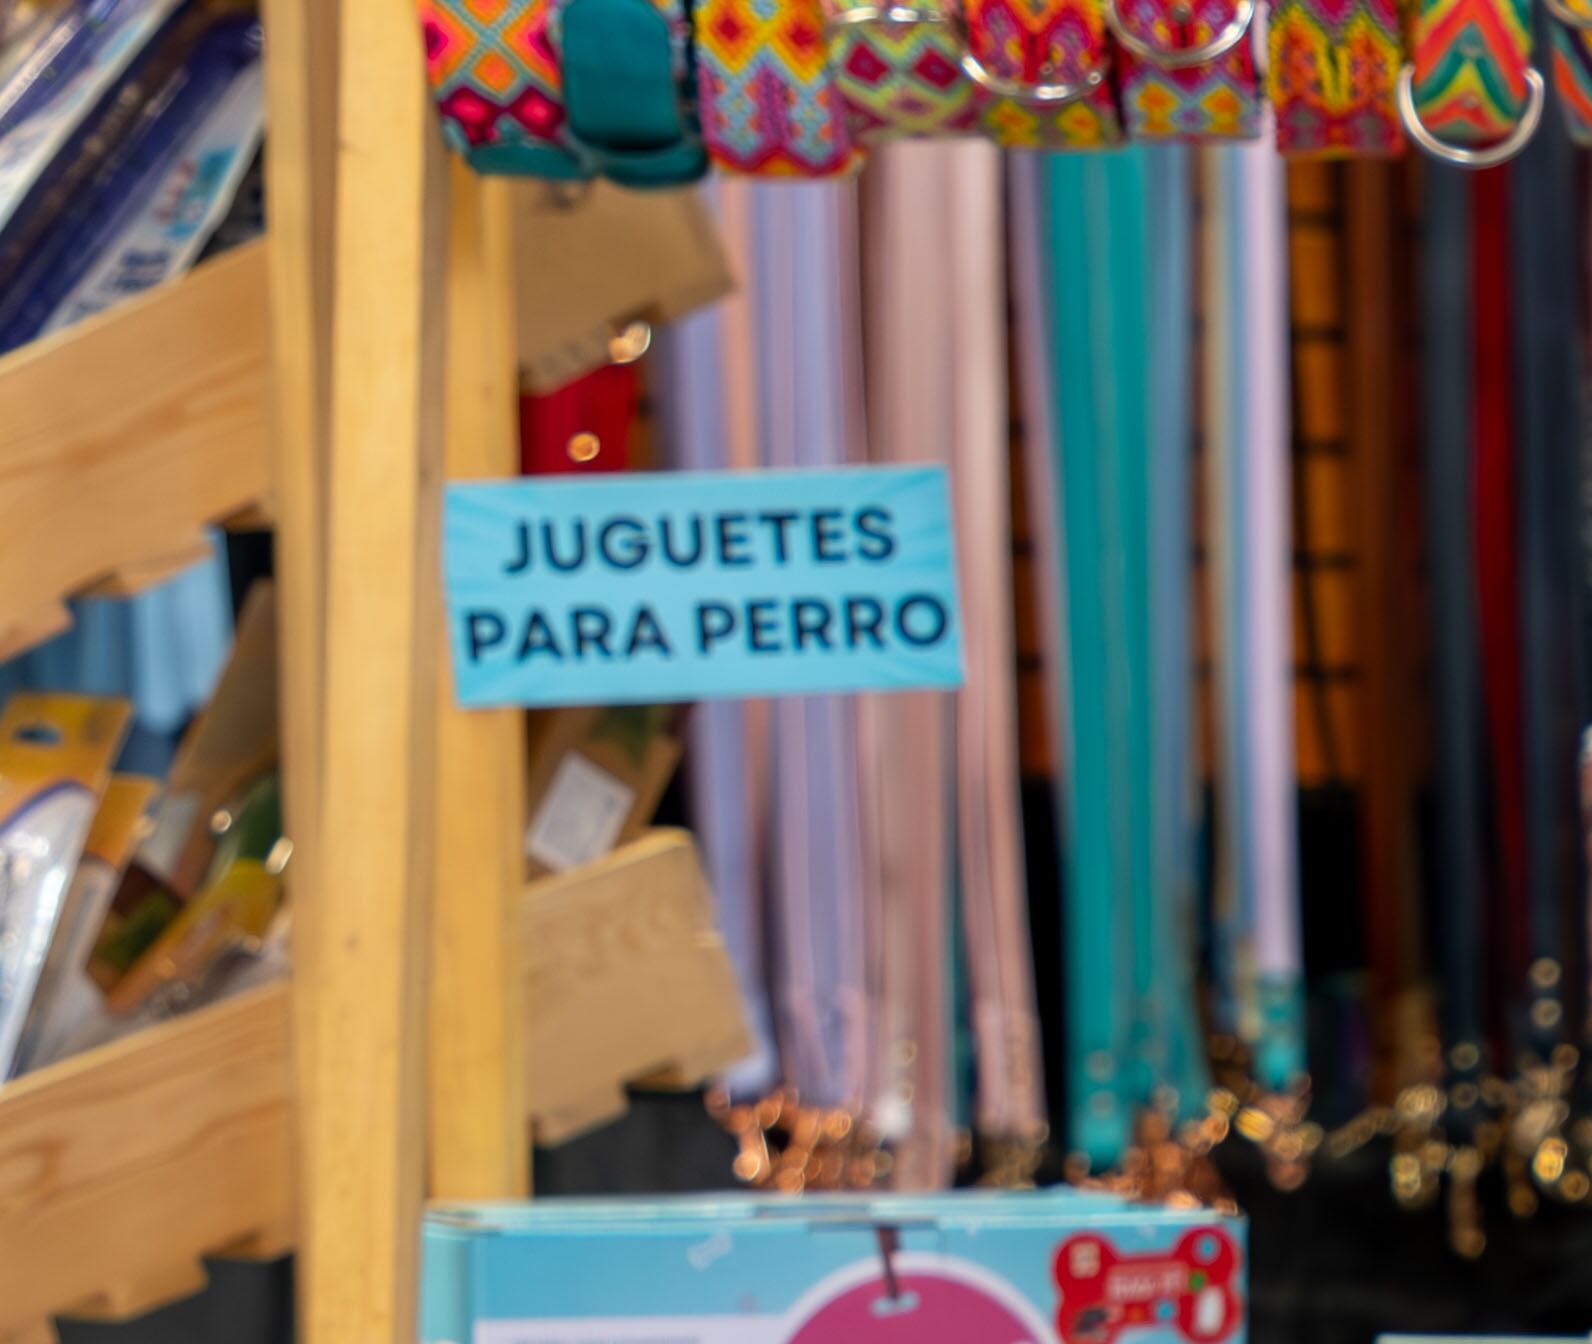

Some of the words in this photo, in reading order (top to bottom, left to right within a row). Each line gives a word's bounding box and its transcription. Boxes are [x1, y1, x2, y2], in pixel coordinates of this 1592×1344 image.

[503, 506, 896, 576] JUGUETES
[465, 603, 672, 665] PARA
[695, 592, 949, 657] PERRO
